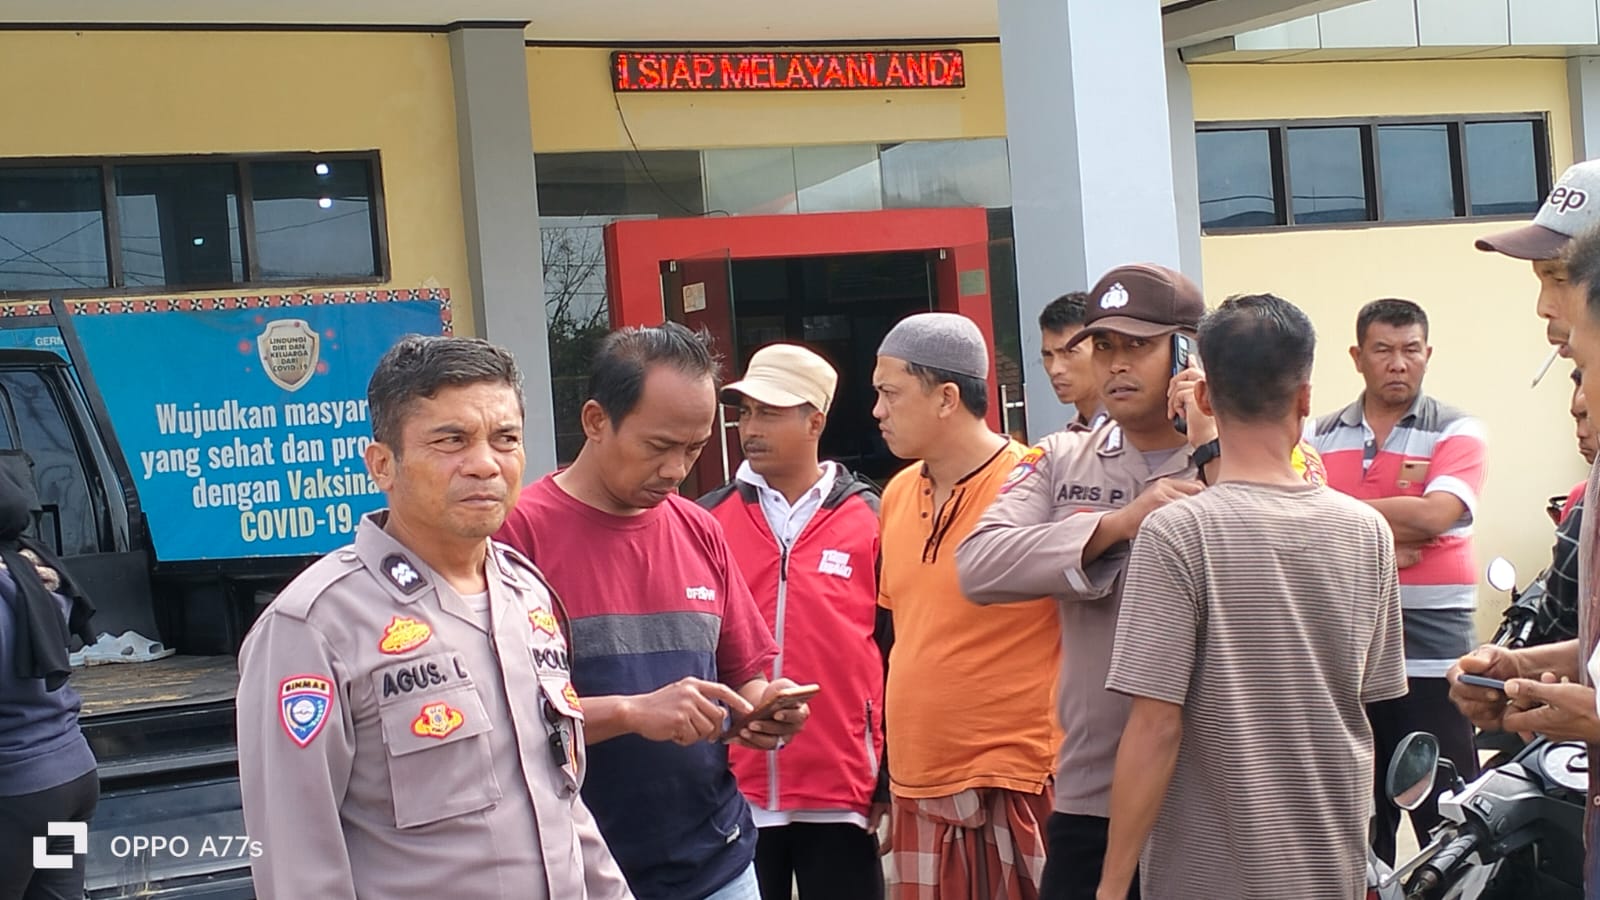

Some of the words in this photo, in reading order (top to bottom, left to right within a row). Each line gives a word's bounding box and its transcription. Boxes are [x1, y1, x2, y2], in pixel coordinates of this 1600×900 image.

[638, 56, 716, 89] SIAP
[885, 53, 963, 87] ANDA
[270, 350, 308, 358] KELUARGA
[155, 400, 277, 439] Wujudkan
[140, 447, 202, 480] yang
[207, 437, 275, 469] sehat
[281, 433, 325, 464] dan
[192, 477, 281, 512] dengan
[1057, 484, 1101, 501] ARIS
[1109, 489, 1124, 504] P
[285, 680, 326, 692] BINMAS
[383, 662, 447, 698] AGUS.
[453, 657, 467, 679] L
